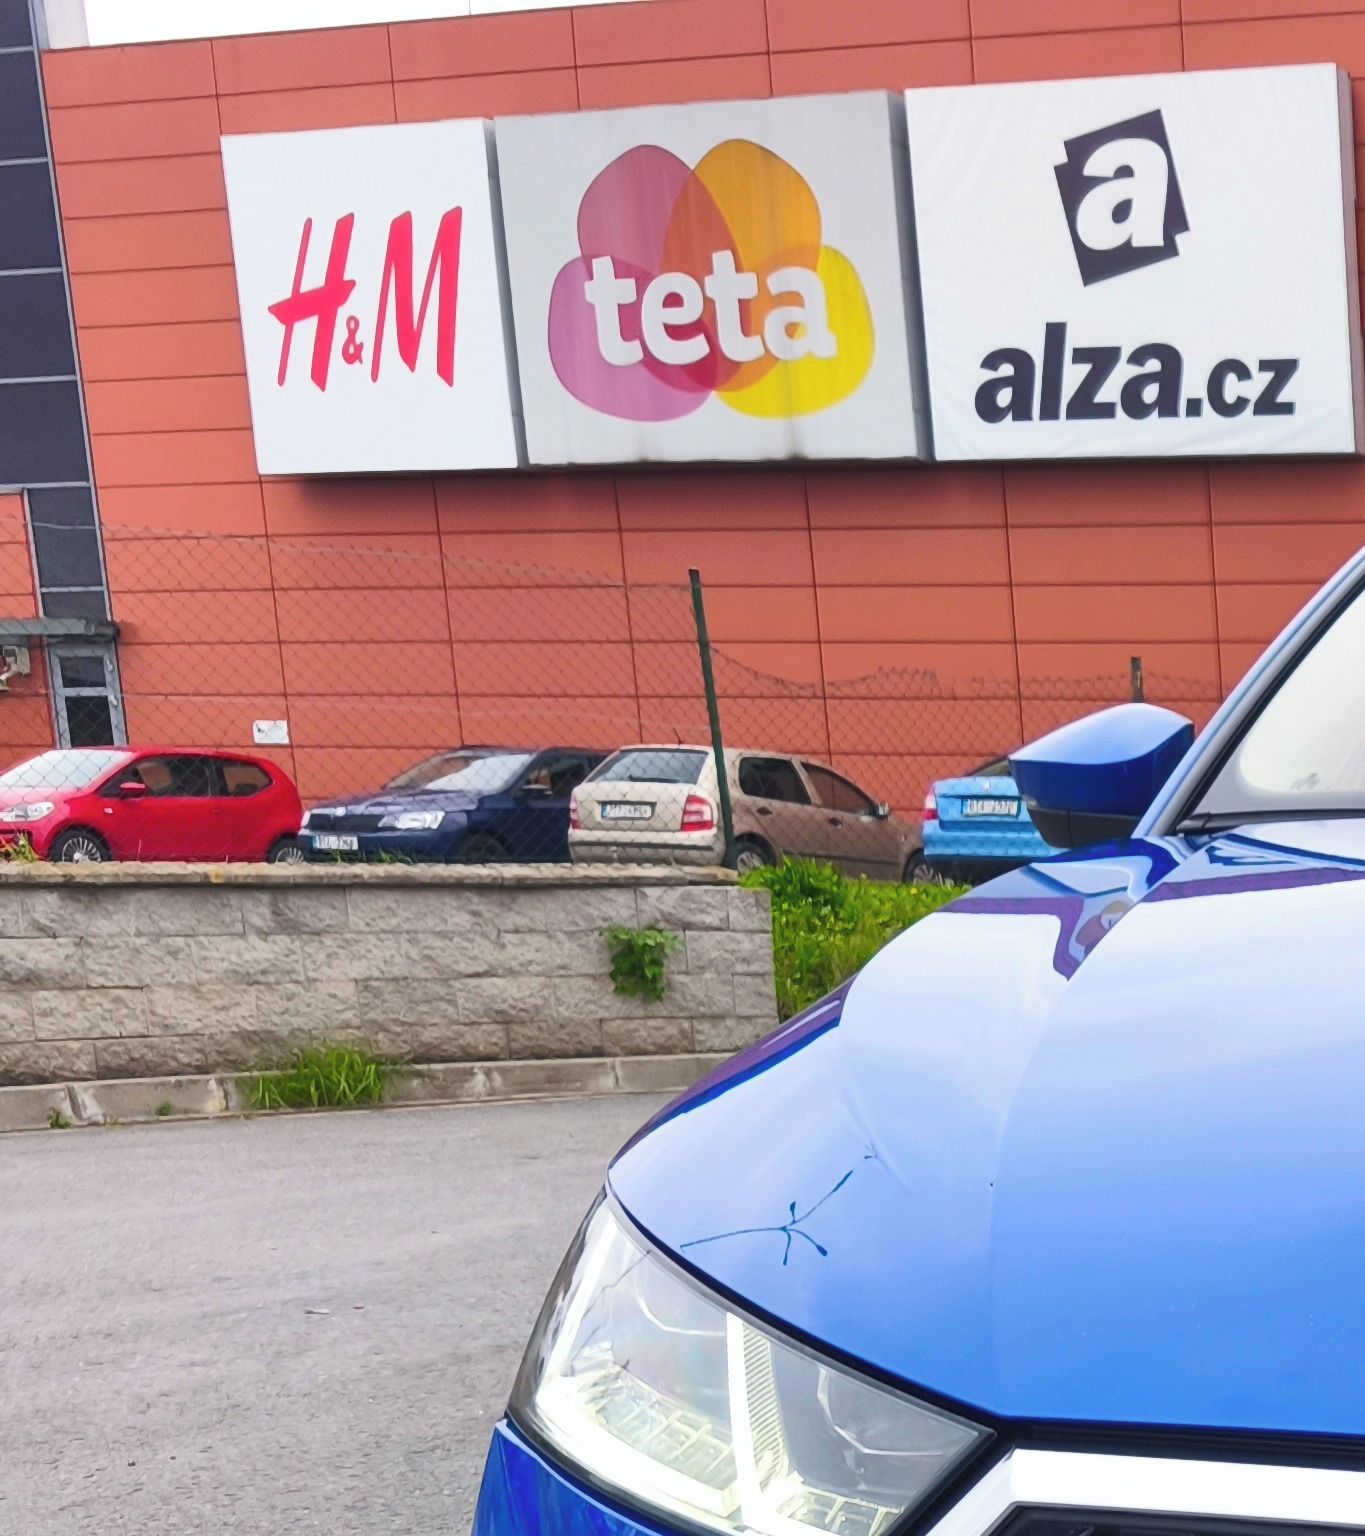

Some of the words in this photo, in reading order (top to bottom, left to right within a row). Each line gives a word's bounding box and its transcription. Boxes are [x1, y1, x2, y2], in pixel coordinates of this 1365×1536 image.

[268, 205, 462, 392] H&M
[583, 249, 838, 366] teta
[974, 321, 1299, 422] alza.cz
